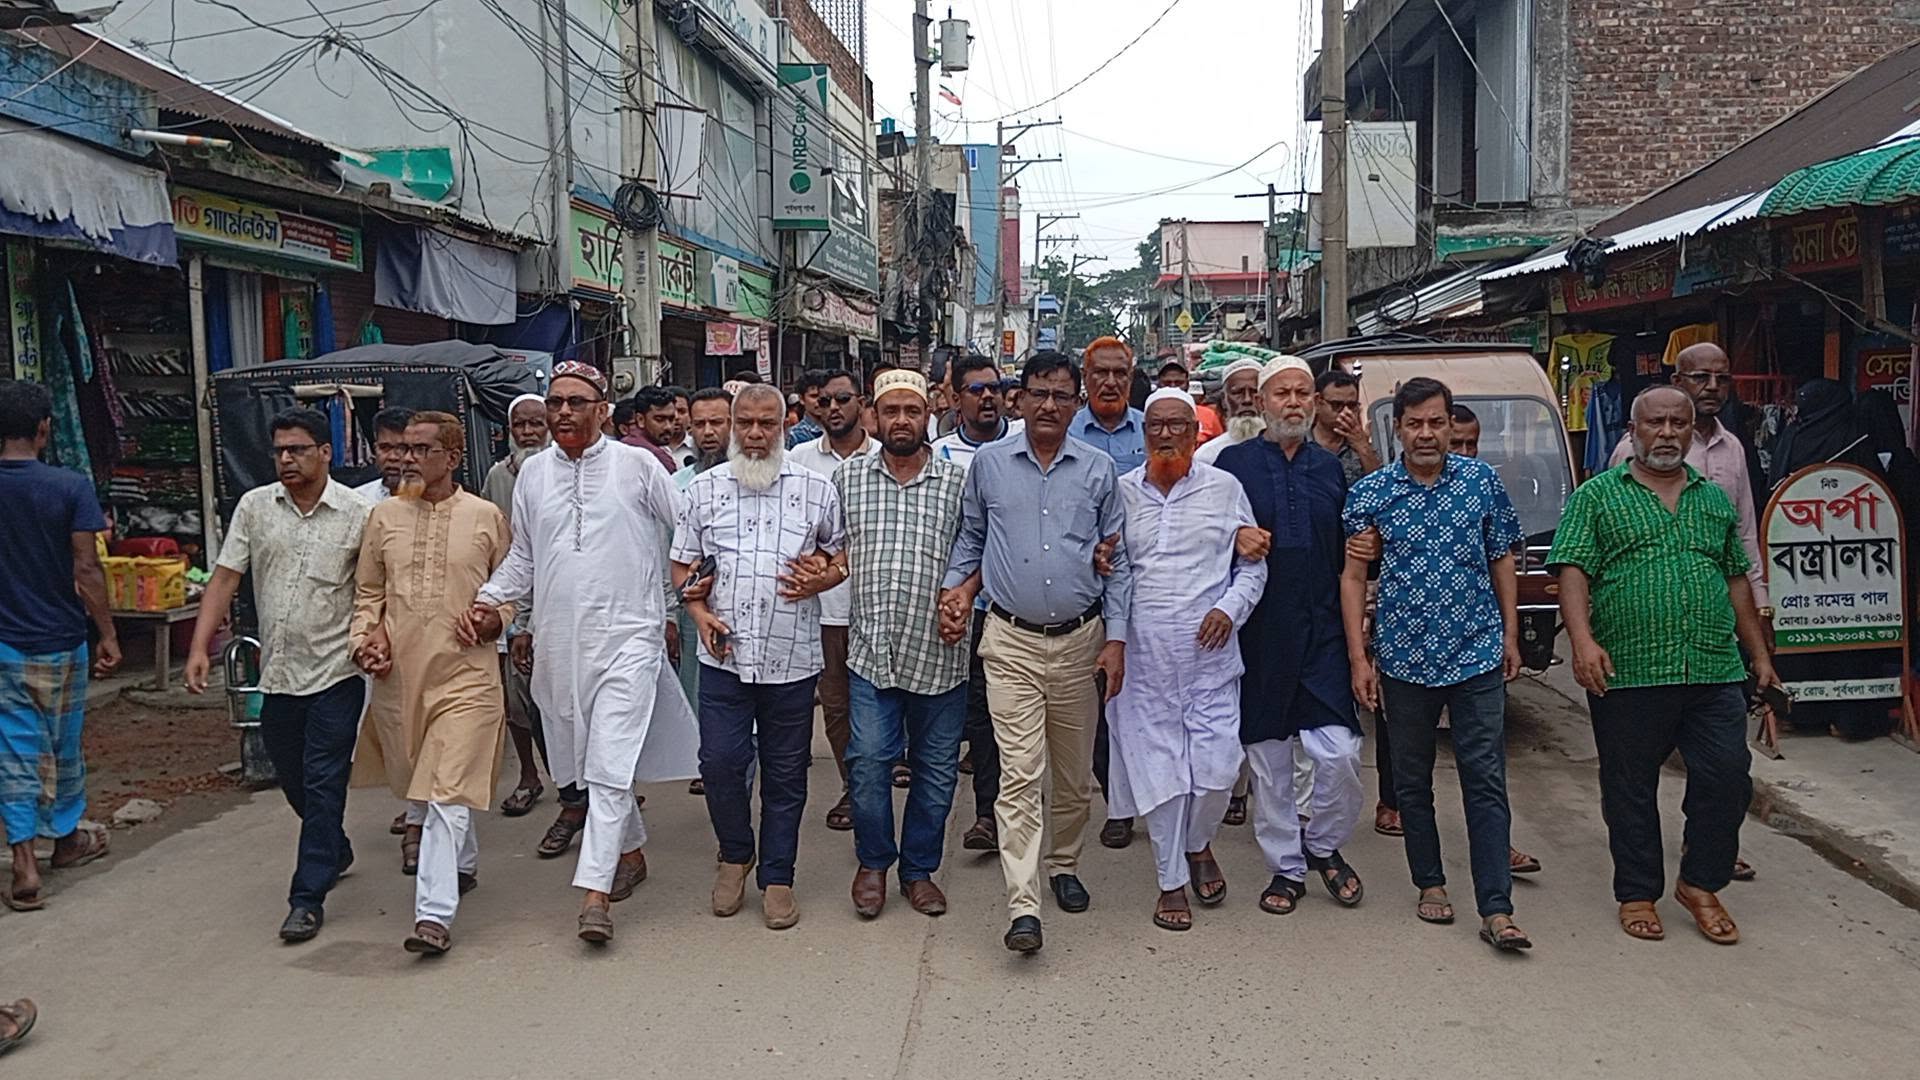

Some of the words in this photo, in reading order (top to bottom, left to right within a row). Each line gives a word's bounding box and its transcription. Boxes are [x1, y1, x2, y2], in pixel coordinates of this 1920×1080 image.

[792, 124, 807, 170] NRBC
[171, 194, 200, 227] তি
[204, 206, 279, 243] গার্মেন্টস
[1821, 478, 1839, 490] নিউ
[1777, 482, 1883, 535] অর্পা
[1768, 534, 1900, 584] বস্ত্রালয়
[1813, 592, 1856, 607] রমেন্দ্র
[1861, 591, 1889, 606] পাল
[1868, 683, 1896, 694] বাজার
